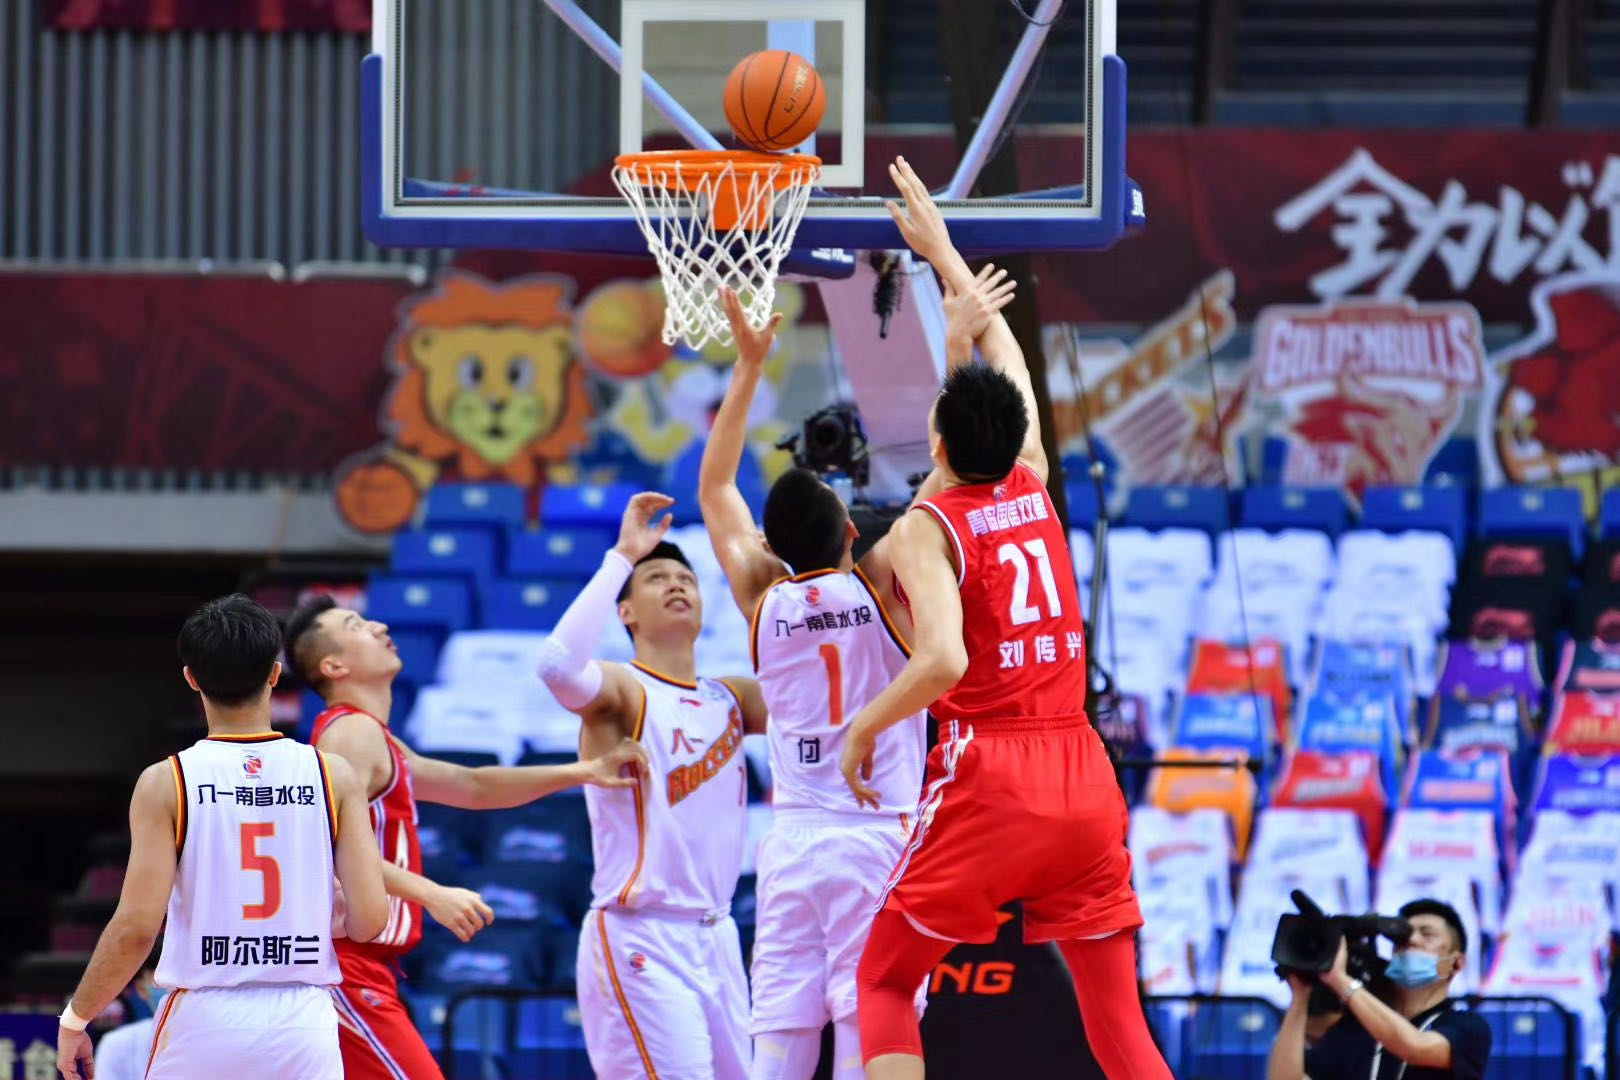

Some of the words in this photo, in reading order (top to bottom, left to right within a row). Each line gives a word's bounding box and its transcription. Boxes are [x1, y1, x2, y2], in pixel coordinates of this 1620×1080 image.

[1263, 315, 1478, 388] GOLDENBULLS
[965, 491, 1049, 538] 青岛国信双星
[775, 605, 873, 638] 八一南昌水投
[818, 643, 844, 727] 1
[671, 726, 705, 756] 八一
[197, 783, 316, 807] 八一南昌水投
[239, 822, 283, 921] 5
[201, 935, 320, 966] 阿尔斯兰
